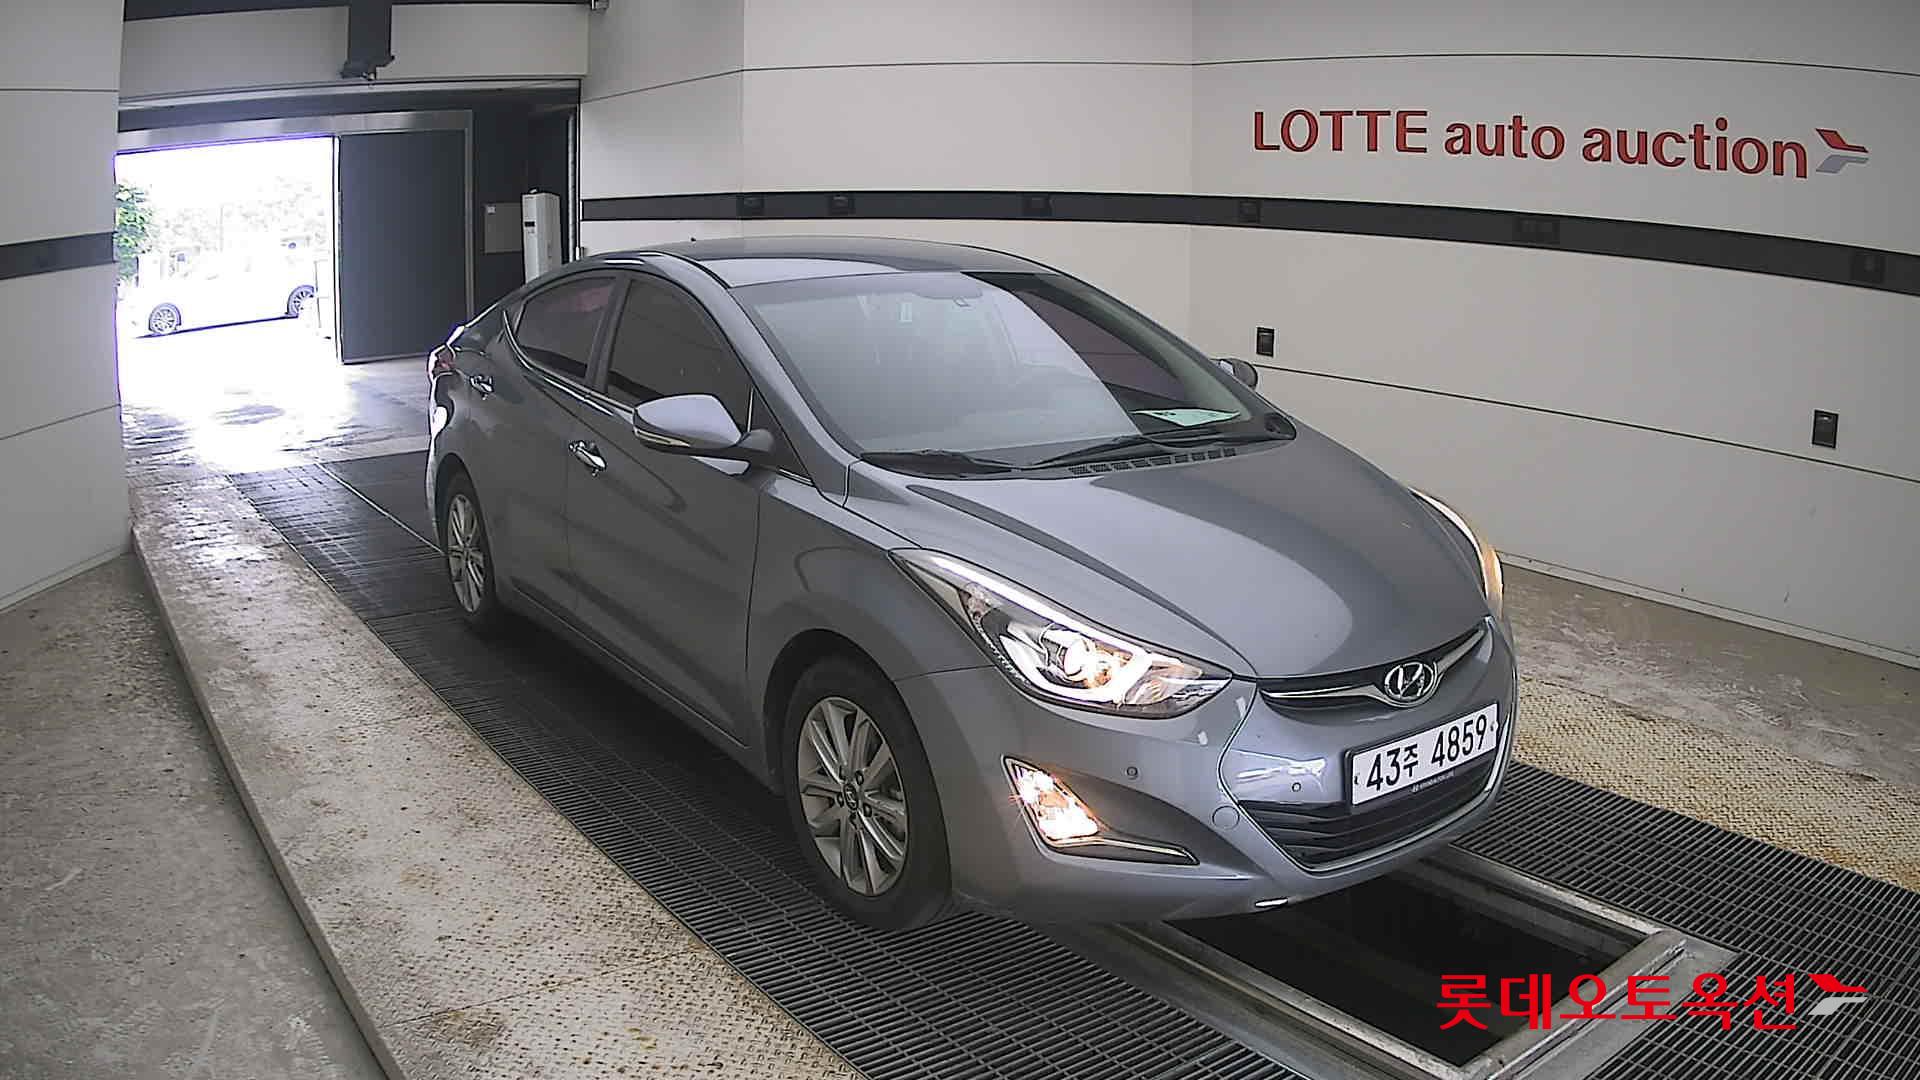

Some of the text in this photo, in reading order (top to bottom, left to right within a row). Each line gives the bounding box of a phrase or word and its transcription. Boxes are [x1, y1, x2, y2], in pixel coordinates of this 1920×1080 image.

[1253, 109, 1809, 179] LOTTE auto auction
[1366, 743, 1419, 792] 43주
[1430, 713, 1488, 768] 4859
